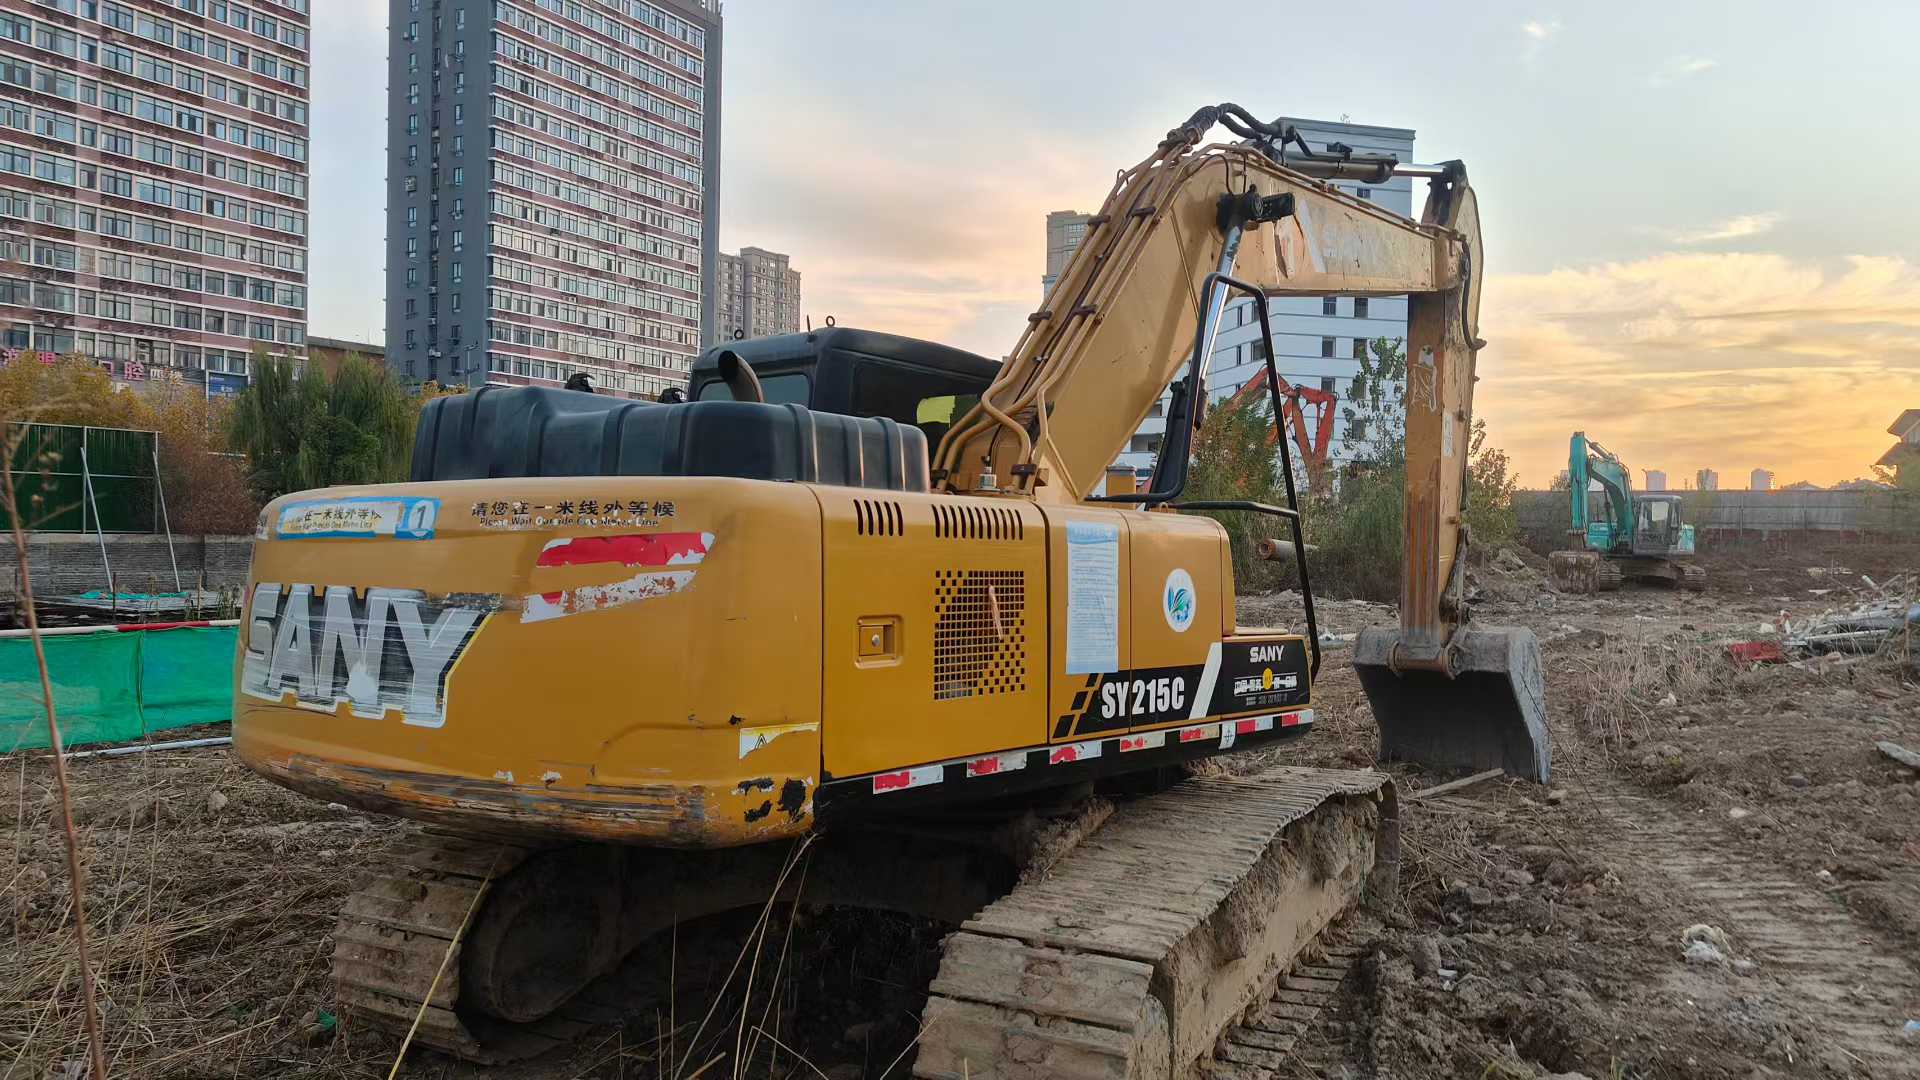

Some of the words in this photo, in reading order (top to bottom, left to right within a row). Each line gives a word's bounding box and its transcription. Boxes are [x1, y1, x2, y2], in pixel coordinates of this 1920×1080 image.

[415, 504, 427, 529] 1
[471, 500, 676, 517] 请您在一米线外等候
[242, 582, 486, 726] SANY
[1249, 645, 1284, 663] SANY
